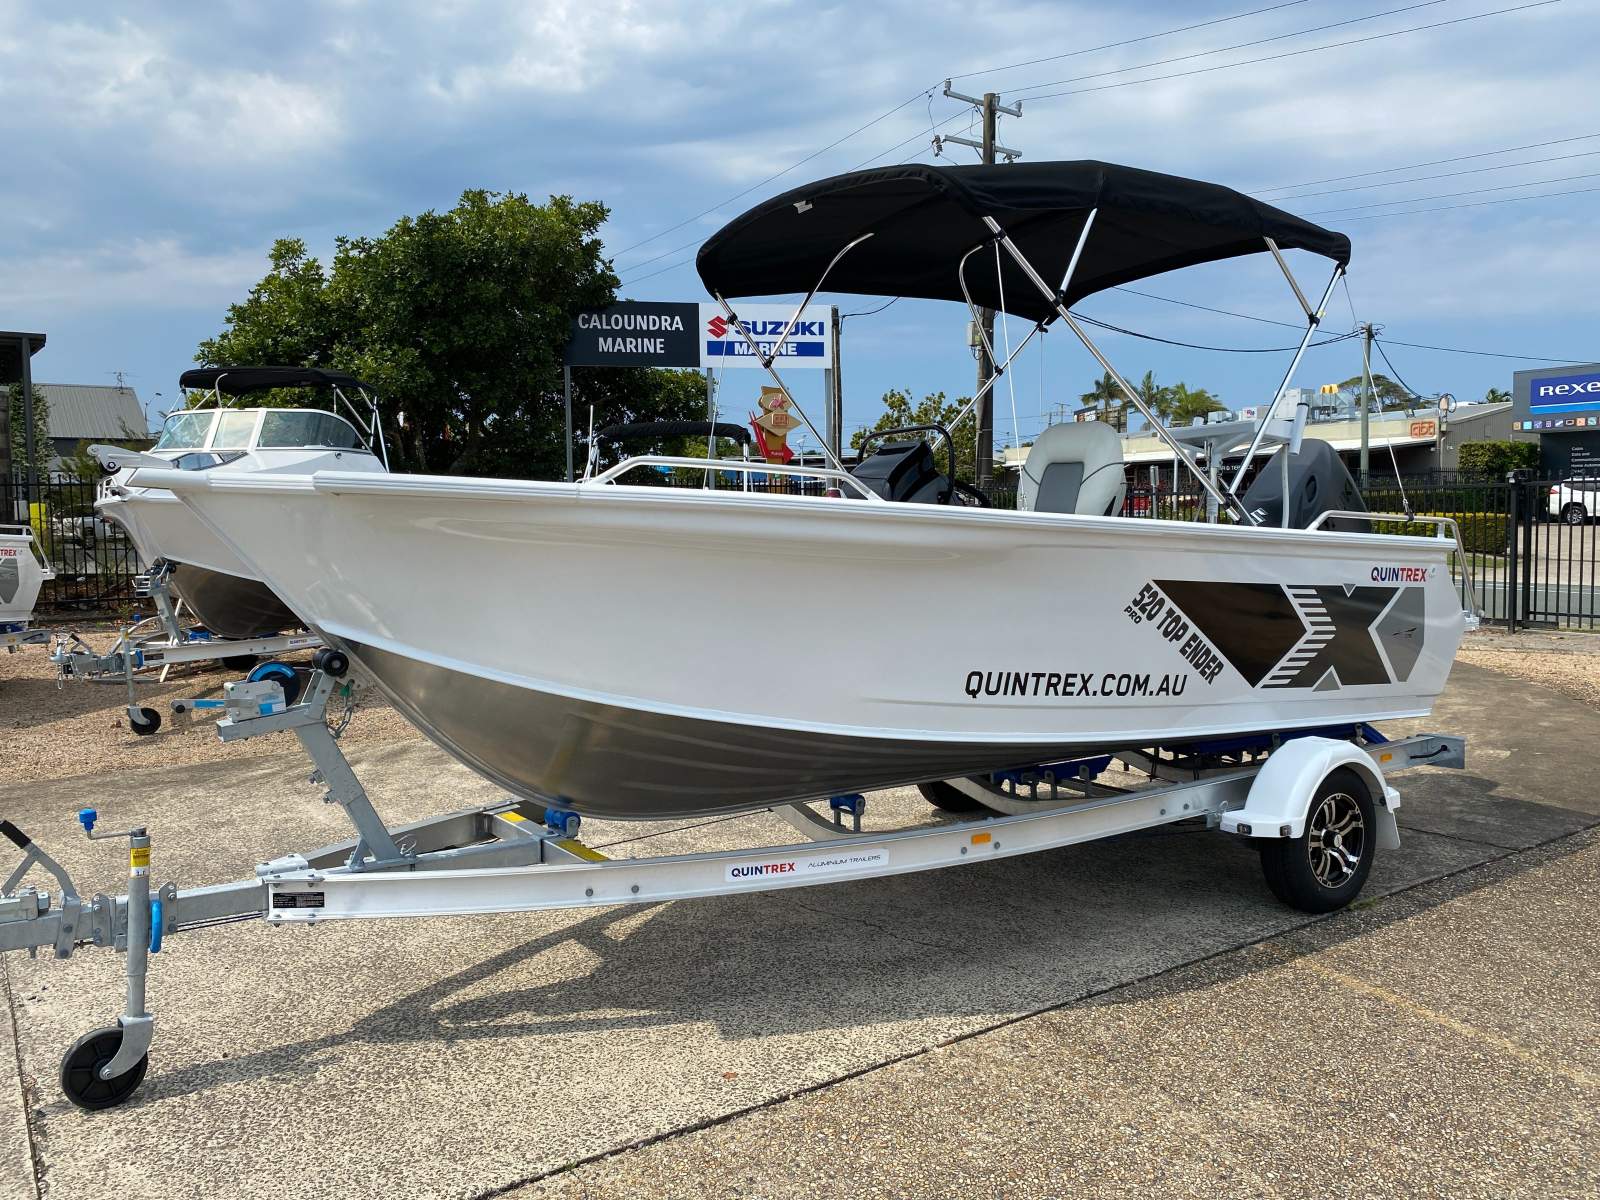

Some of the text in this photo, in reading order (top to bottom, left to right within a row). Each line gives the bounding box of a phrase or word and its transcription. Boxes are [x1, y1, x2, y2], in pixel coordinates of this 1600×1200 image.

[578, 313, 684, 331] CALOUNDRA
[598, 337, 665, 354] MARINE
[1371, 567, 1428, 582] QUINTREX
[1124, 605, 1142, 624] PRO
[1132, 582, 1224, 685] 520 TOP ENDER
[965, 671, 1187, 698] QUINTREX.COM.AU
[731, 862, 796, 878] QUINTREX
[850, 854, 881, 863] TRAILERS
